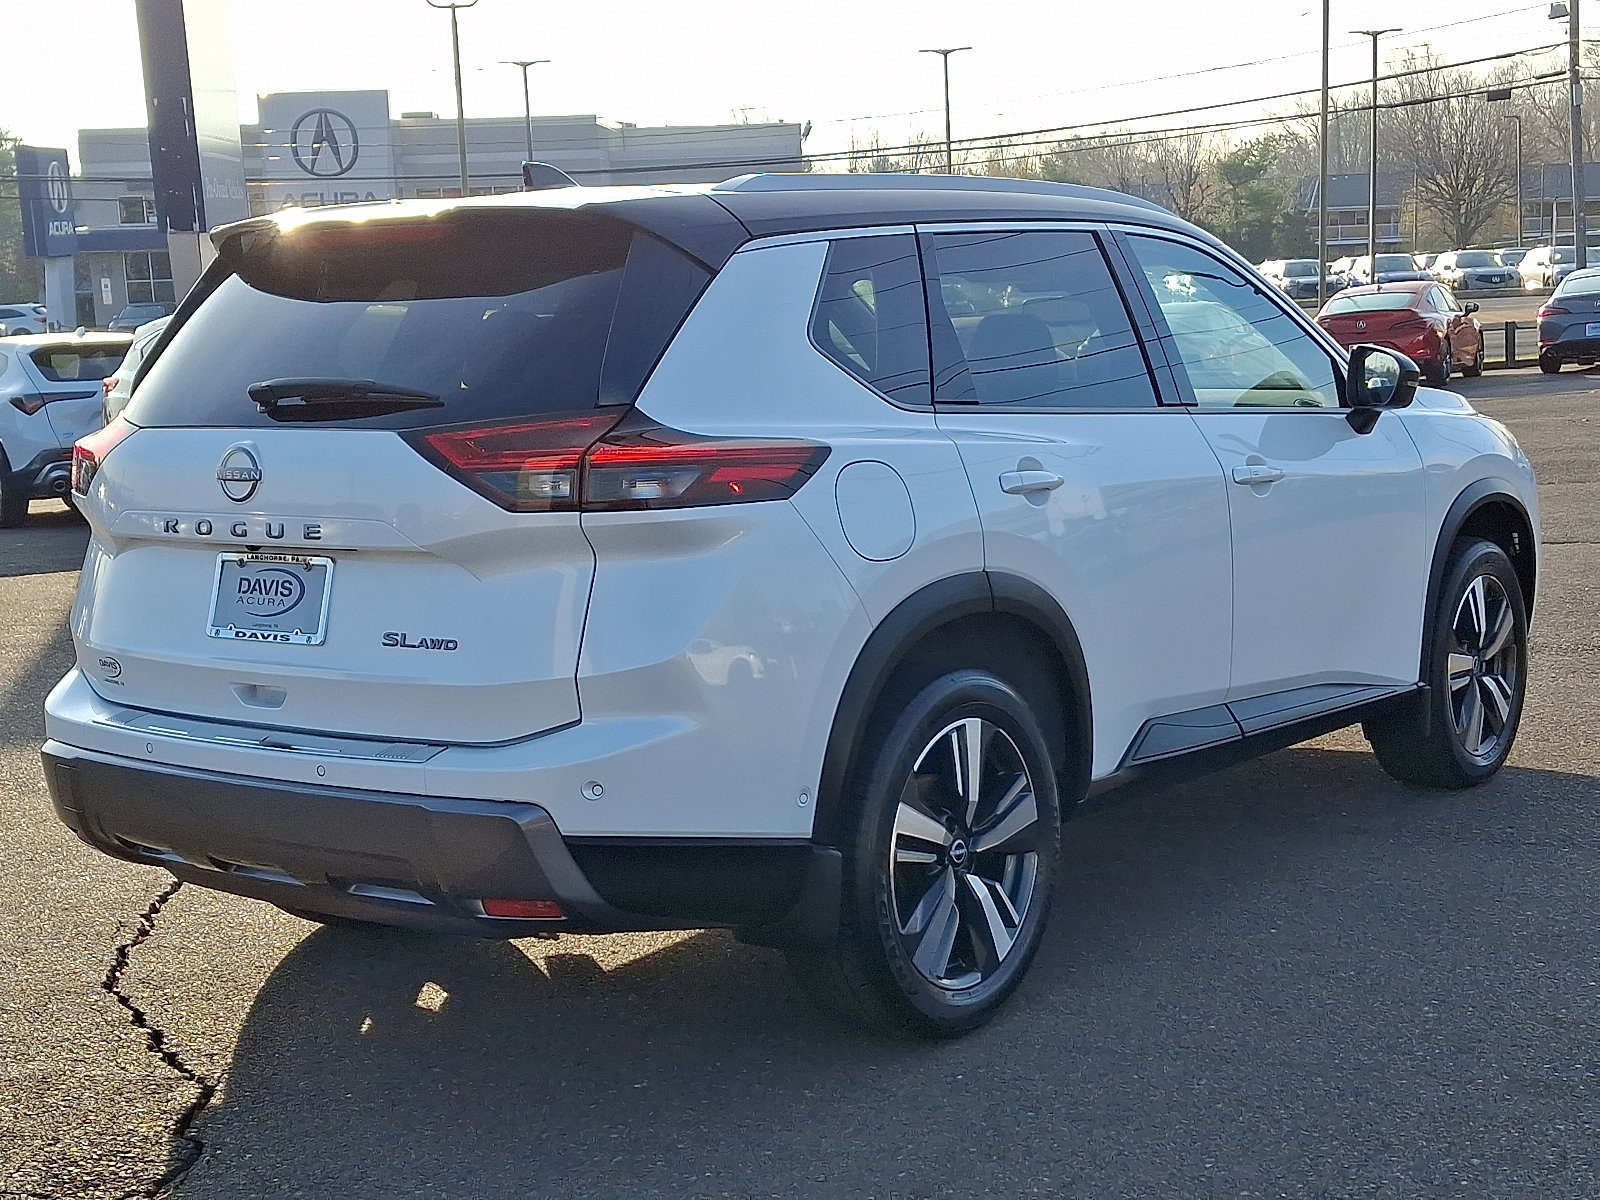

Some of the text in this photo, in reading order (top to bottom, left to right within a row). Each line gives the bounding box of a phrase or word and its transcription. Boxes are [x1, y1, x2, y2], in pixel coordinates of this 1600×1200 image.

[49, 221, 75, 236] ACURA
[216, 469, 260, 480] NISSAN
[163, 518, 322, 540] ROGUE
[237, 577, 293, 598] DAVIS
[235, 596, 286, 608] ACURA
[234, 631, 291, 642] DAVIS
